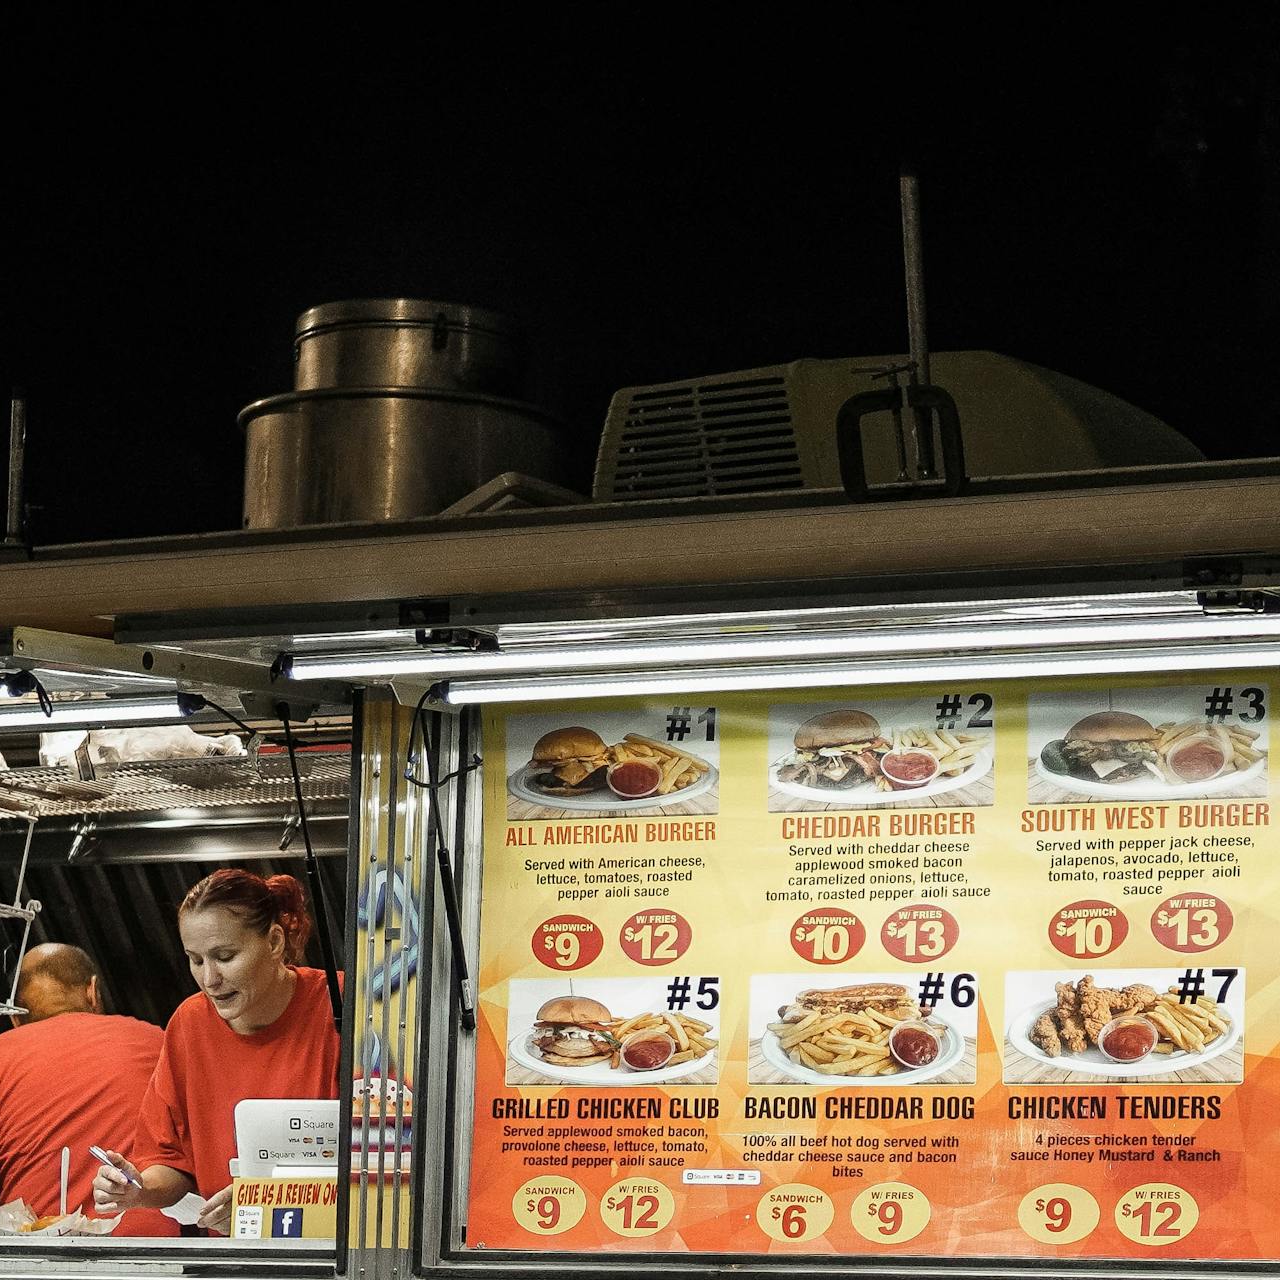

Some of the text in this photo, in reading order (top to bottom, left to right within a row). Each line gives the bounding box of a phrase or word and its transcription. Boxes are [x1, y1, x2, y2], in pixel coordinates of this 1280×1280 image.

[936, 693, 994, 730] #2
[1205, 687, 1266, 723] #3
[666, 706, 716, 741] #1
[506, 821, 717, 847] ALL AMERICAN BURGER
[782, 812, 975, 840] CHEDDAR BURGER
[1020, 803, 1270, 833] SOUTH WEST BURGER
[524, 855, 706, 870] Served with American cheese,
[536, 870, 693, 886] lettuce, tomatoes, roasted
[558, 886, 670, 900] pepper aioli sauce
[543, 923, 594, 932] SANDWICH
[636, 914, 677, 924] W/ FRIES
[1056, 917, 1114, 954] $10
[1157, 908, 1220, 945] $13
[544, 933, 579, 967] $9
[624, 924, 678, 960] $12
[795, 923, 850, 959] $10
[887, 918, 946, 956] $13
[667, 976, 719, 1010] #5
[919, 973, 976, 1008] #6
[1178, 969, 1238, 1004] #7
[492, 1097, 720, 1120] GRILLED CHICKEN CLUB
[745, 1096, 975, 1119] BACON CHEDDAR DOG
[1008, 1095, 1221, 1121] CHICKEN TENDERS
[303, 1120, 334, 1130] Square
[270, 1151, 295, 1159] Square
[237, 1183, 338, 1205] GIVE US A REVIEW ON
[527, 1196, 561, 1229] $9
[607, 1196, 659, 1229] $12
[771, 1204, 807, 1238] $6
[868, 1201, 904, 1235] $9
[1035, 1198, 1072, 1232] $9
[1122, 1201, 1183, 1237] $12
